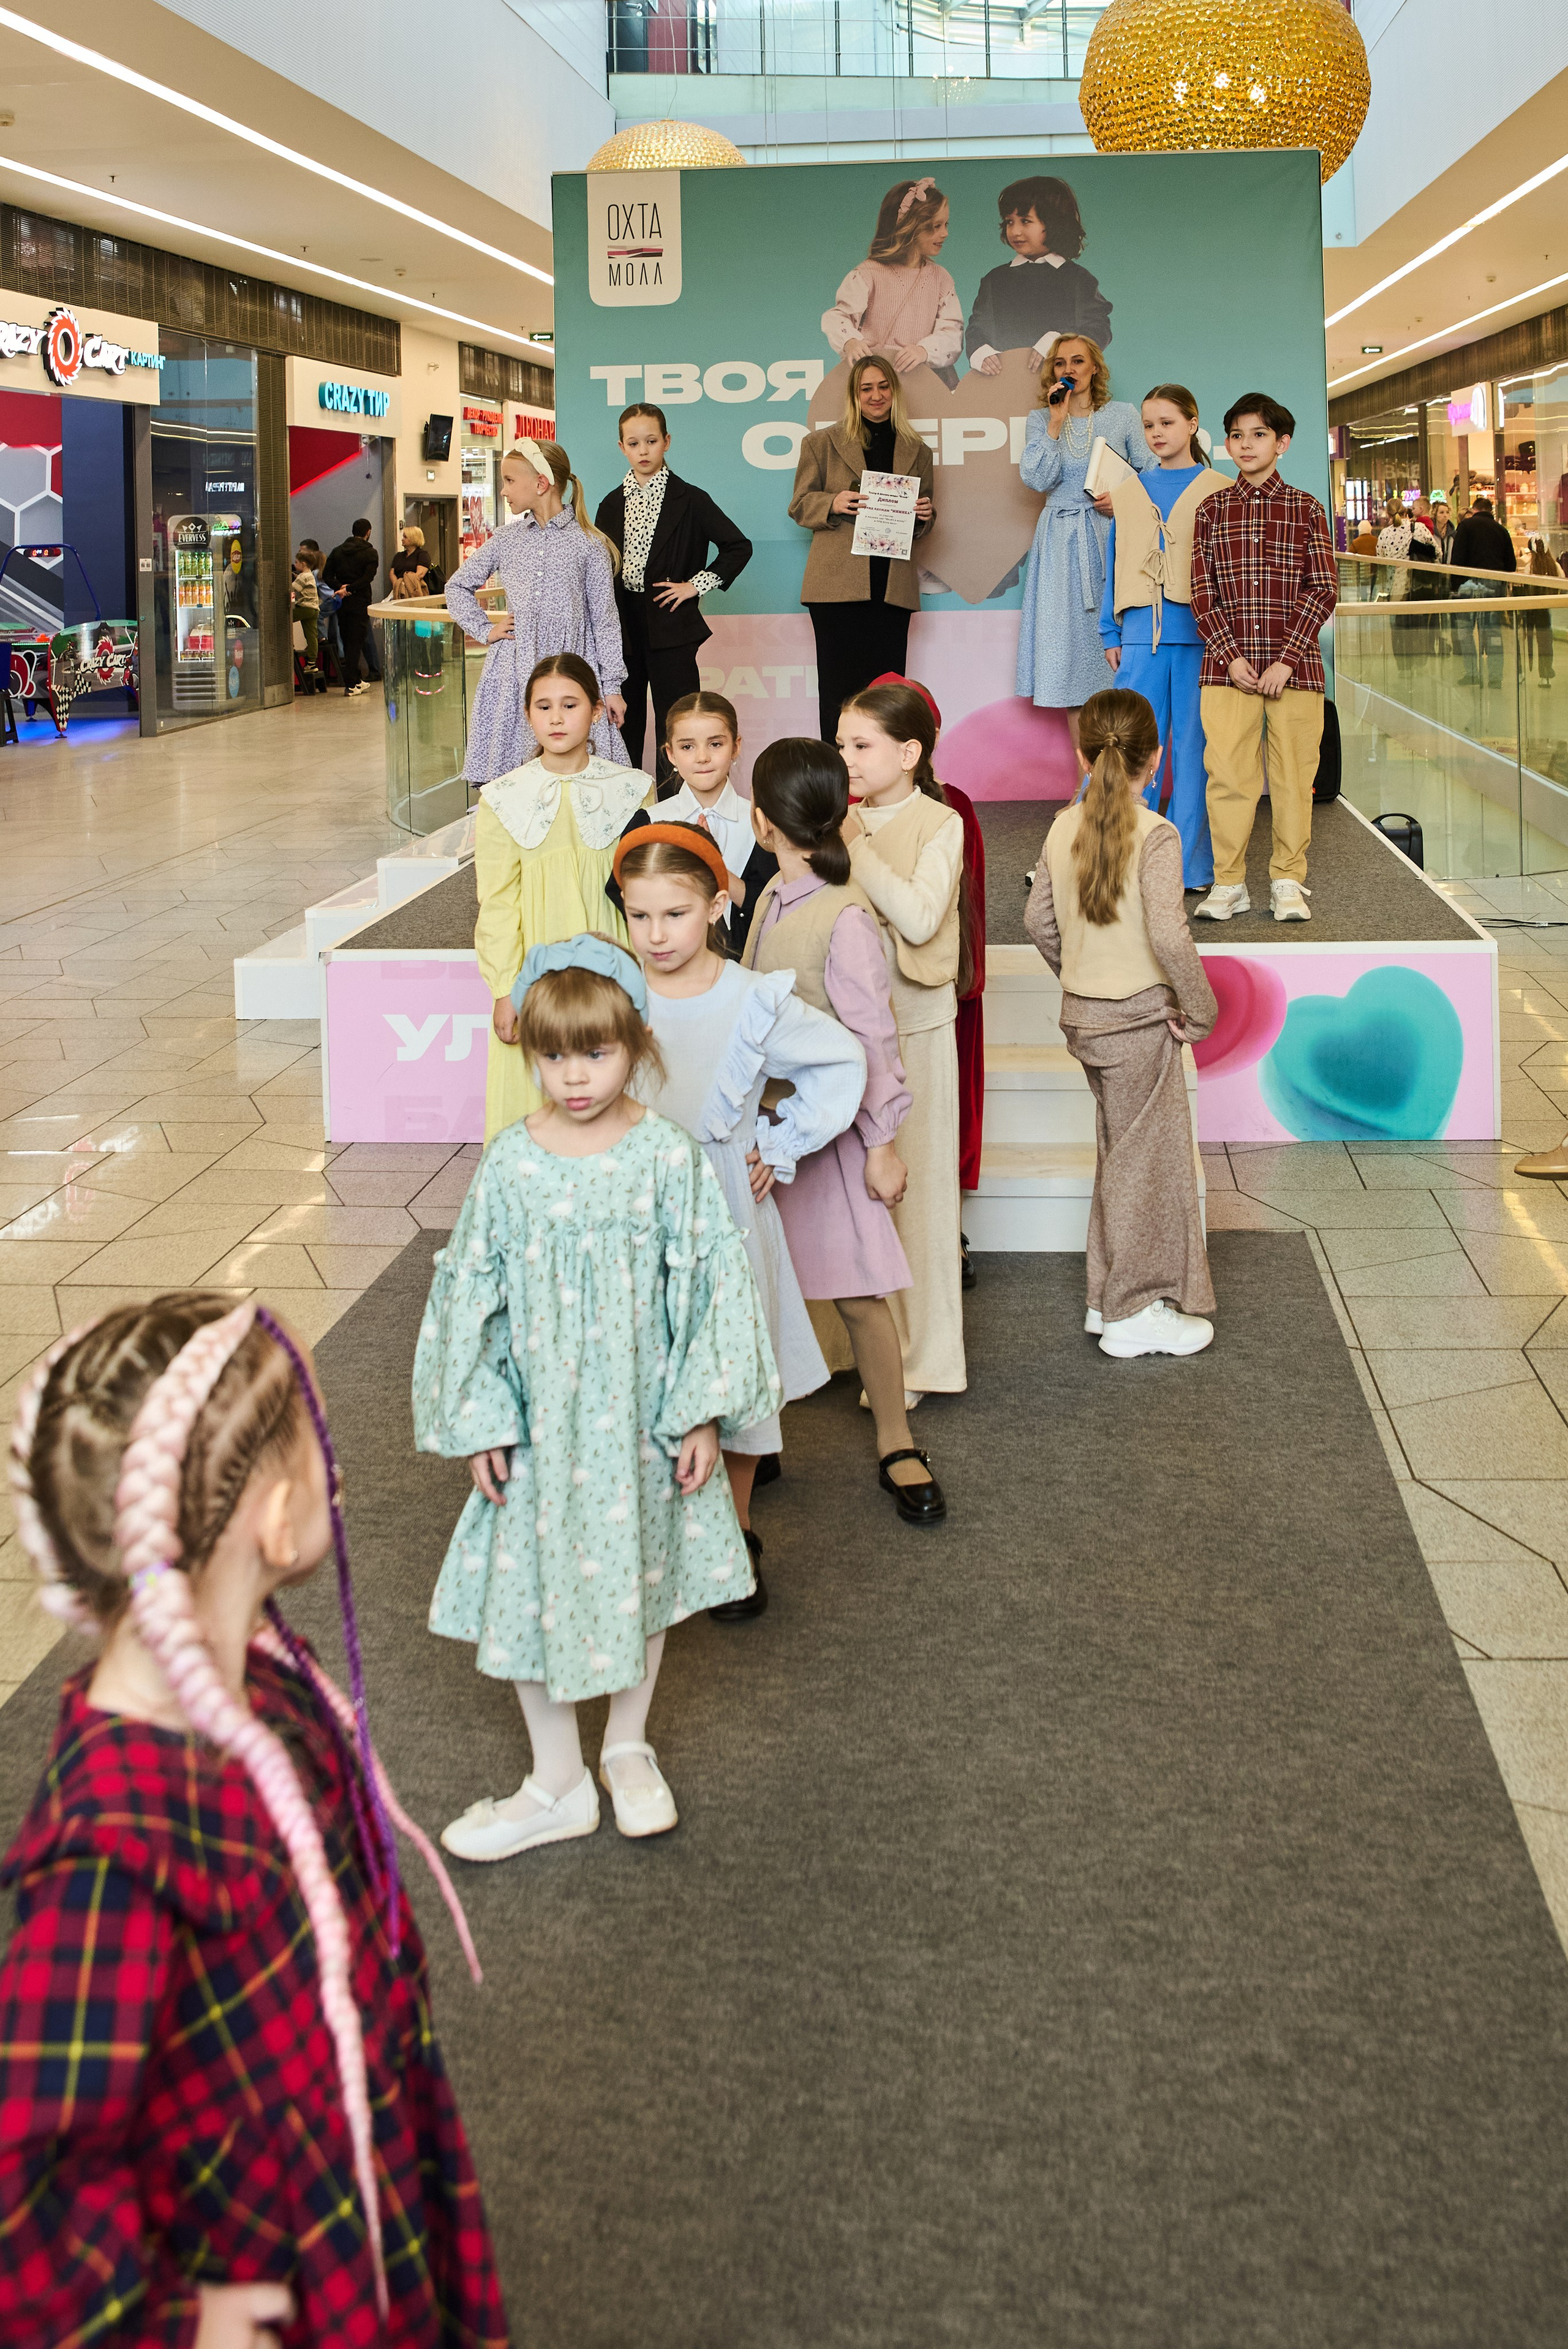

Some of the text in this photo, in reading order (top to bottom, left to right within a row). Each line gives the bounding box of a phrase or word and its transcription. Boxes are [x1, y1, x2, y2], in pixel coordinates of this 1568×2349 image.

[607, 203, 662, 241] ОХТА
[609, 262, 662, 287] МОЛЛ
[0, 320, 130, 375] RAZY CART
[130, 350, 166, 370] КАРТИНГ
[589, 359, 824, 406] ТВОЯ
[323, 381, 390, 417] CRAZY ТИР
[517, 414, 556, 442] ЛЕОНАР
[178, 533, 206, 543] EVERVESS
[80, 652, 126, 673] CRAZY CART
